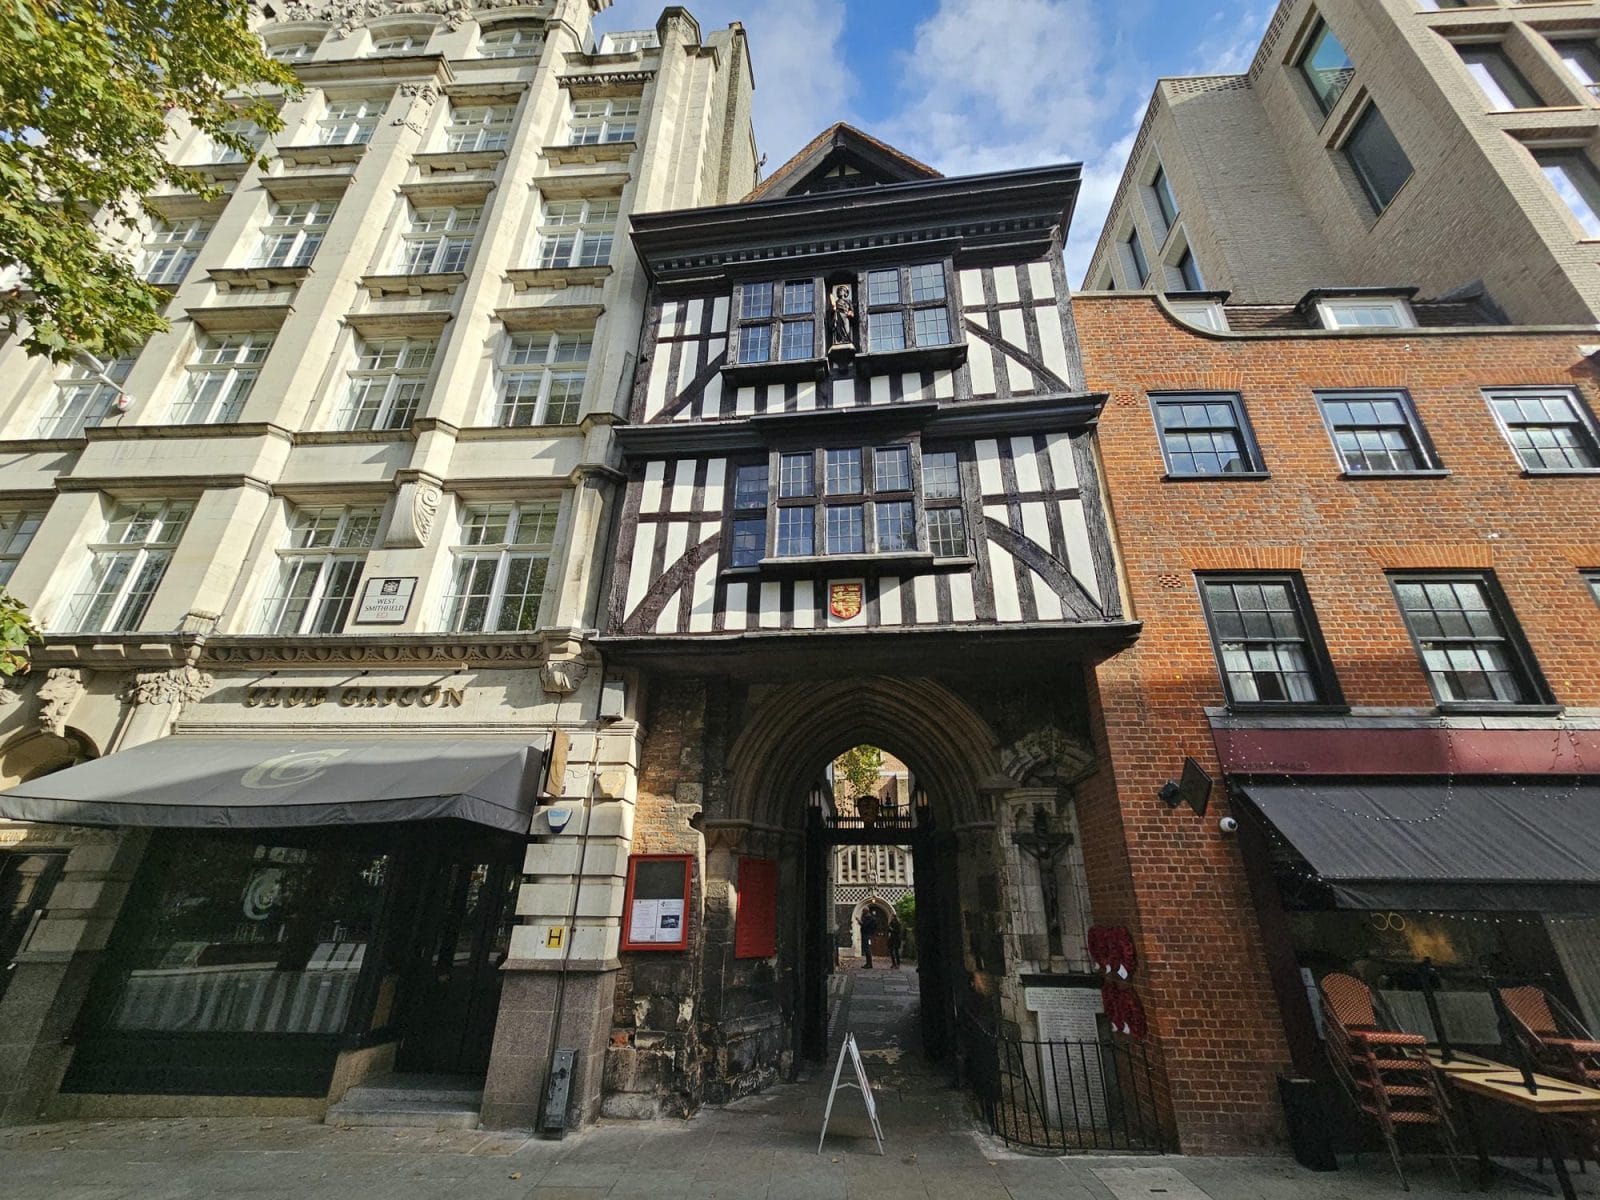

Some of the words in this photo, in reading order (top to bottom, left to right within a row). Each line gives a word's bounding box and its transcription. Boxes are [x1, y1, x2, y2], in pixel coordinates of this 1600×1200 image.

[246, 686, 329, 707] CLUB
[340, 686, 465, 708] GASCON
[547, 928, 562, 946] H
